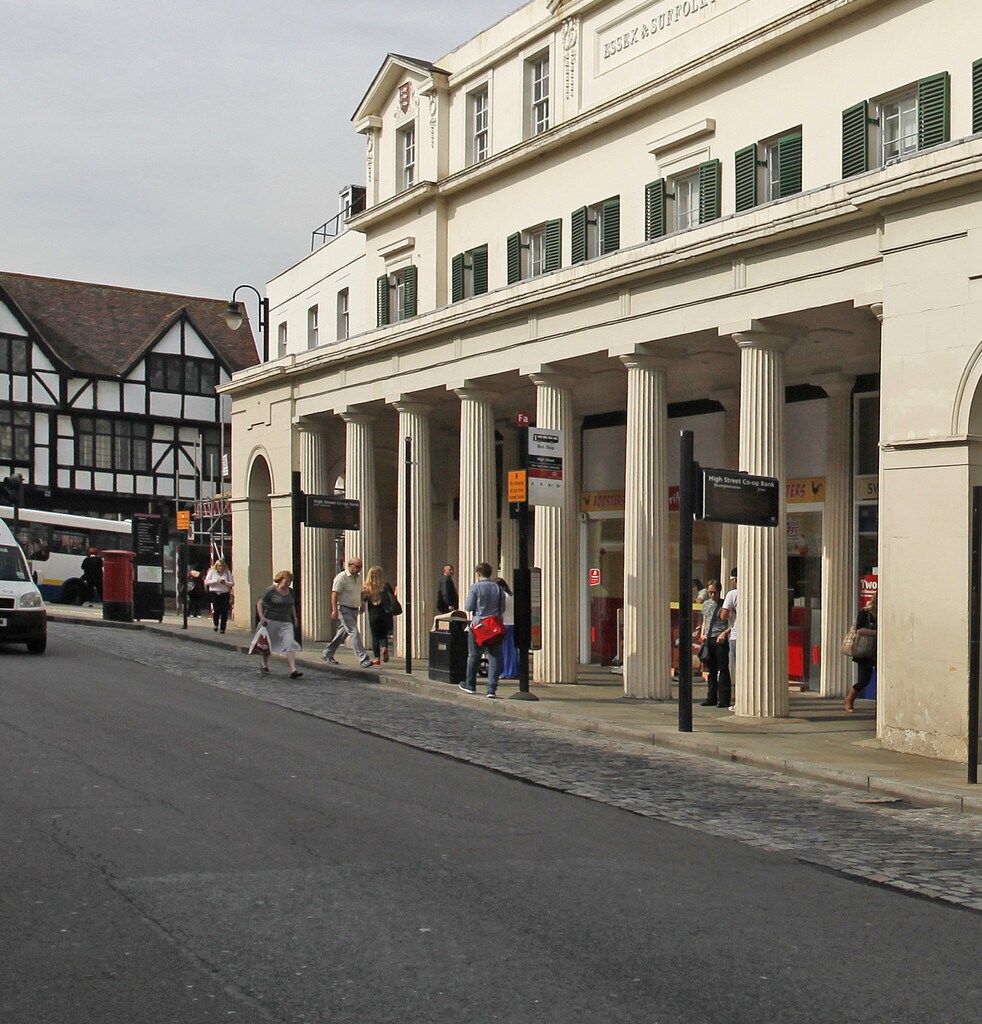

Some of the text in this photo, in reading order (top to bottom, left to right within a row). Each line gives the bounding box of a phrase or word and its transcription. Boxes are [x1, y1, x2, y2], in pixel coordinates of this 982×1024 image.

[604, 27, 638, 59] ESSEX
[641, 24, 649, 39] &
[518, 413, 529, 423] Fa
[708, 476, 723, 484] High
[742, 478, 759, 487] Co-op
